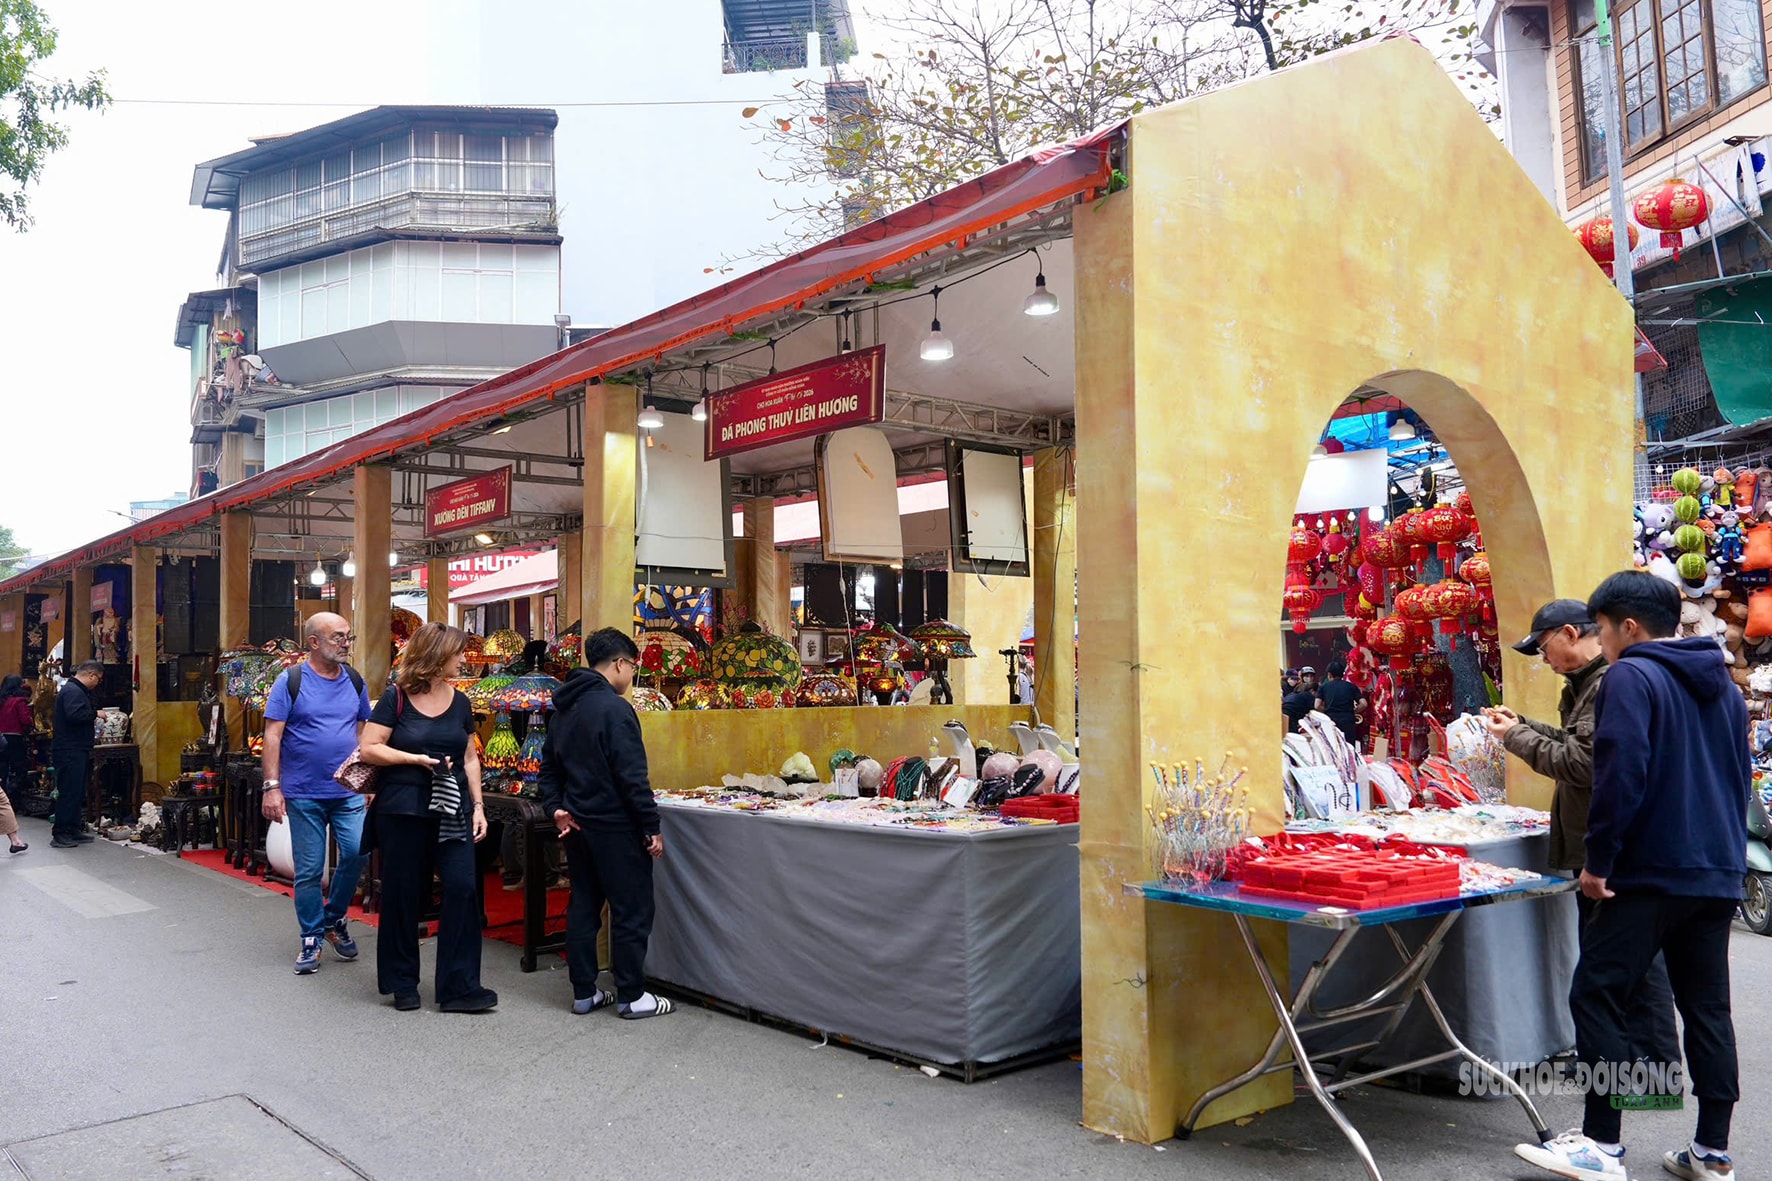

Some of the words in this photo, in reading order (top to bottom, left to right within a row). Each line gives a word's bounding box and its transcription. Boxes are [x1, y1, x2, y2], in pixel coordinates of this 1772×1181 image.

[721, 422, 734, 442] ĐÁ
[735, 416, 767, 438] PHONG
[795, 403, 816, 425] LIÊN
[818, 394, 858, 419] HƯƠNG
[469, 497, 496, 517] TIFFANY
[449, 572, 468, 582] QUÀ
